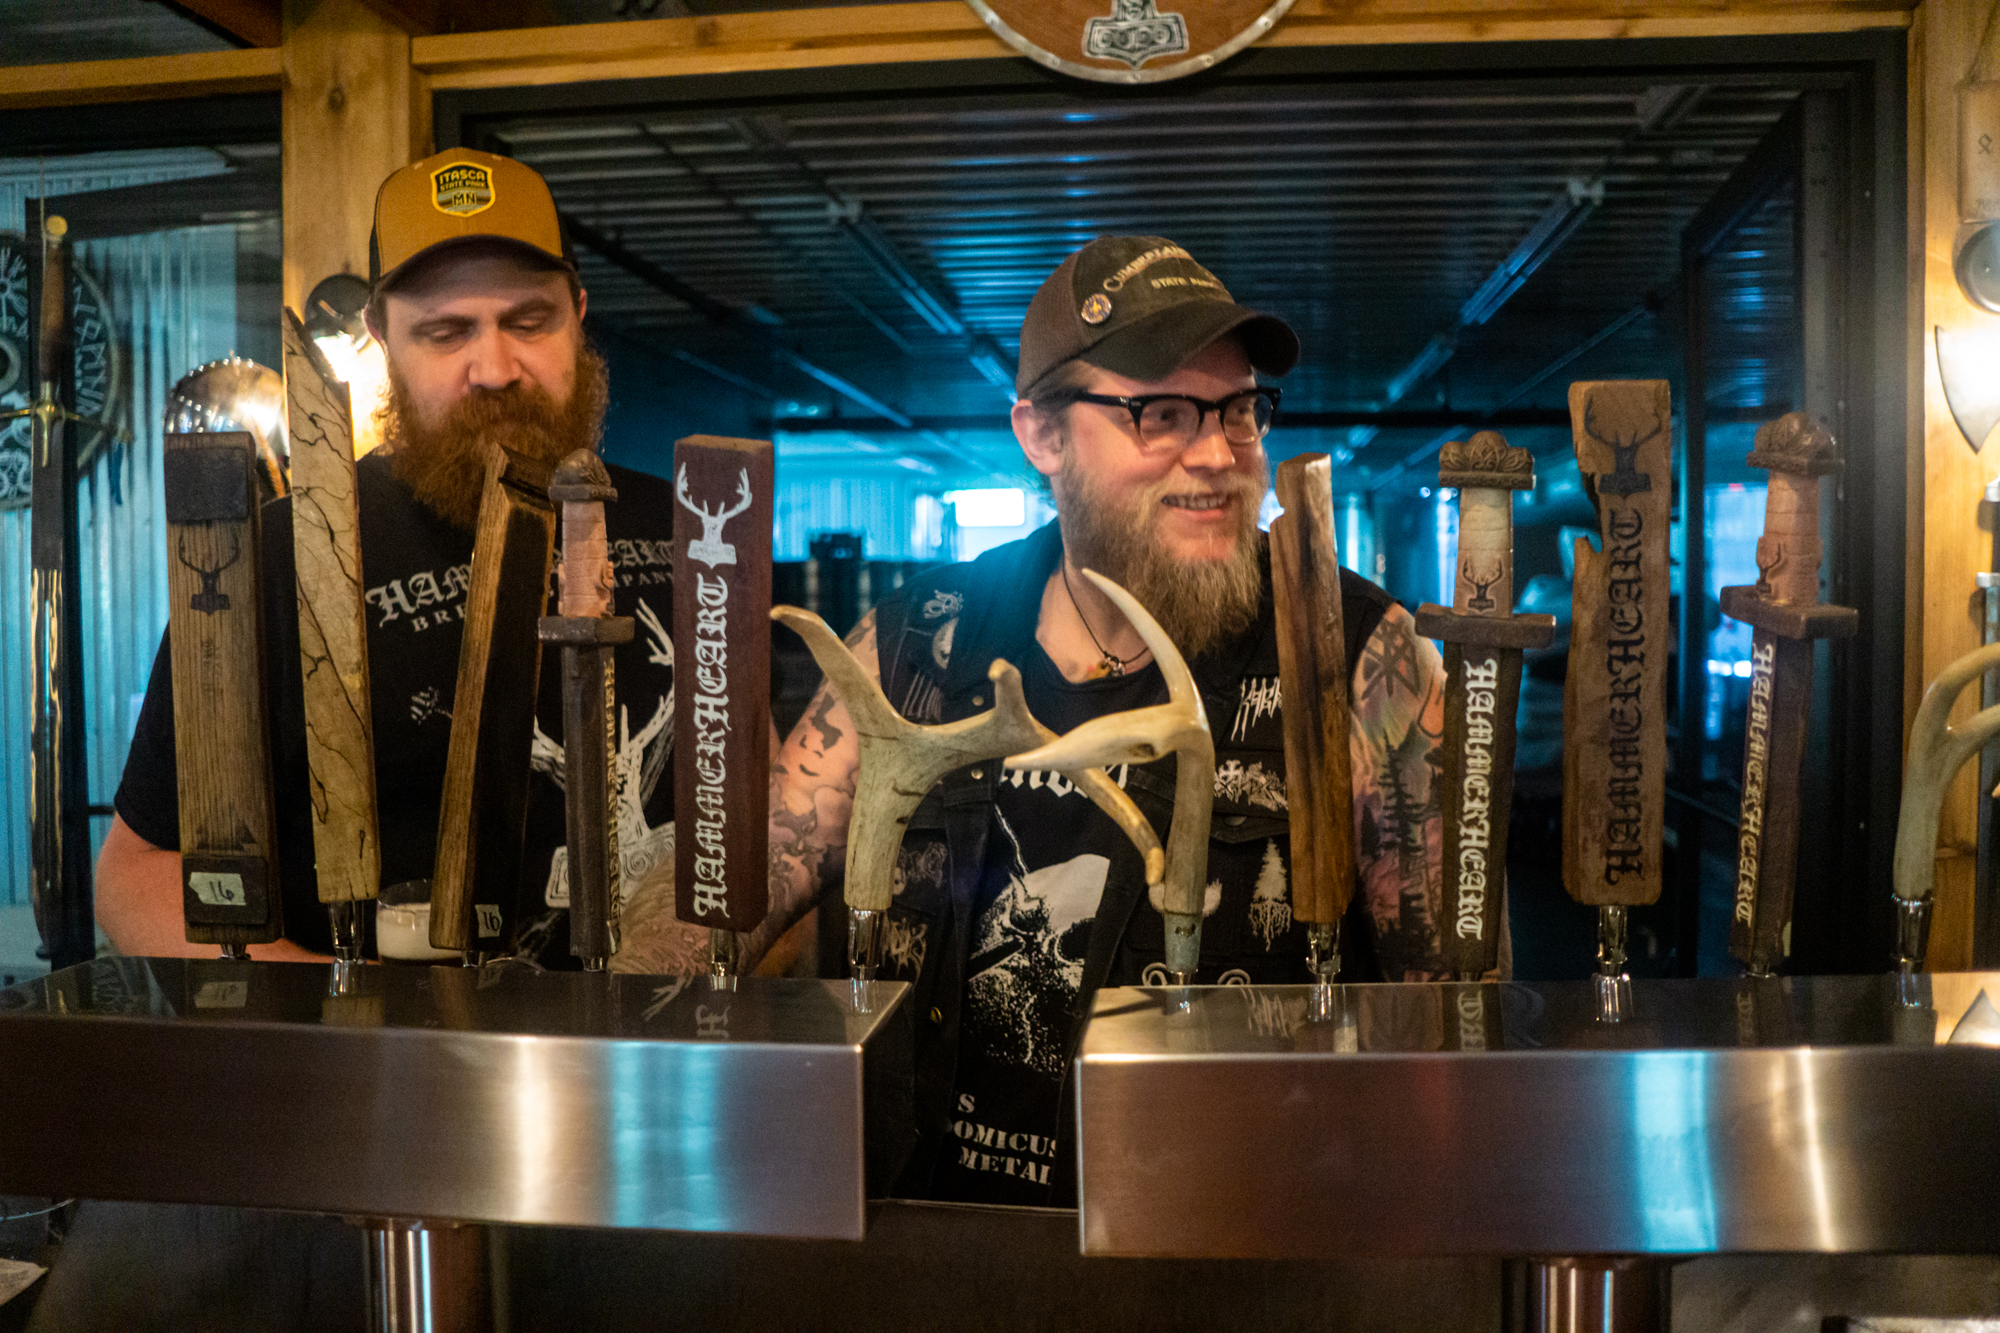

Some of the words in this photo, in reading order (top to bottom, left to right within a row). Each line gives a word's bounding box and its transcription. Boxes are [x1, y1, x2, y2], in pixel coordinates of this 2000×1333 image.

[440, 169, 485, 184] ITASCA
[440, 181, 463, 191] STATE
[453, 193, 476, 205] MN
[1604, 508, 1645, 886] HAMMERHEART
[694, 572, 731, 918] HAMMERHEART
[1736, 643, 1773, 927] HAMMERHEART
[1456, 659, 1497, 940] HAMMERHEART
[210, 881, 235, 902] 16
[483, 911, 500, 932] 16
